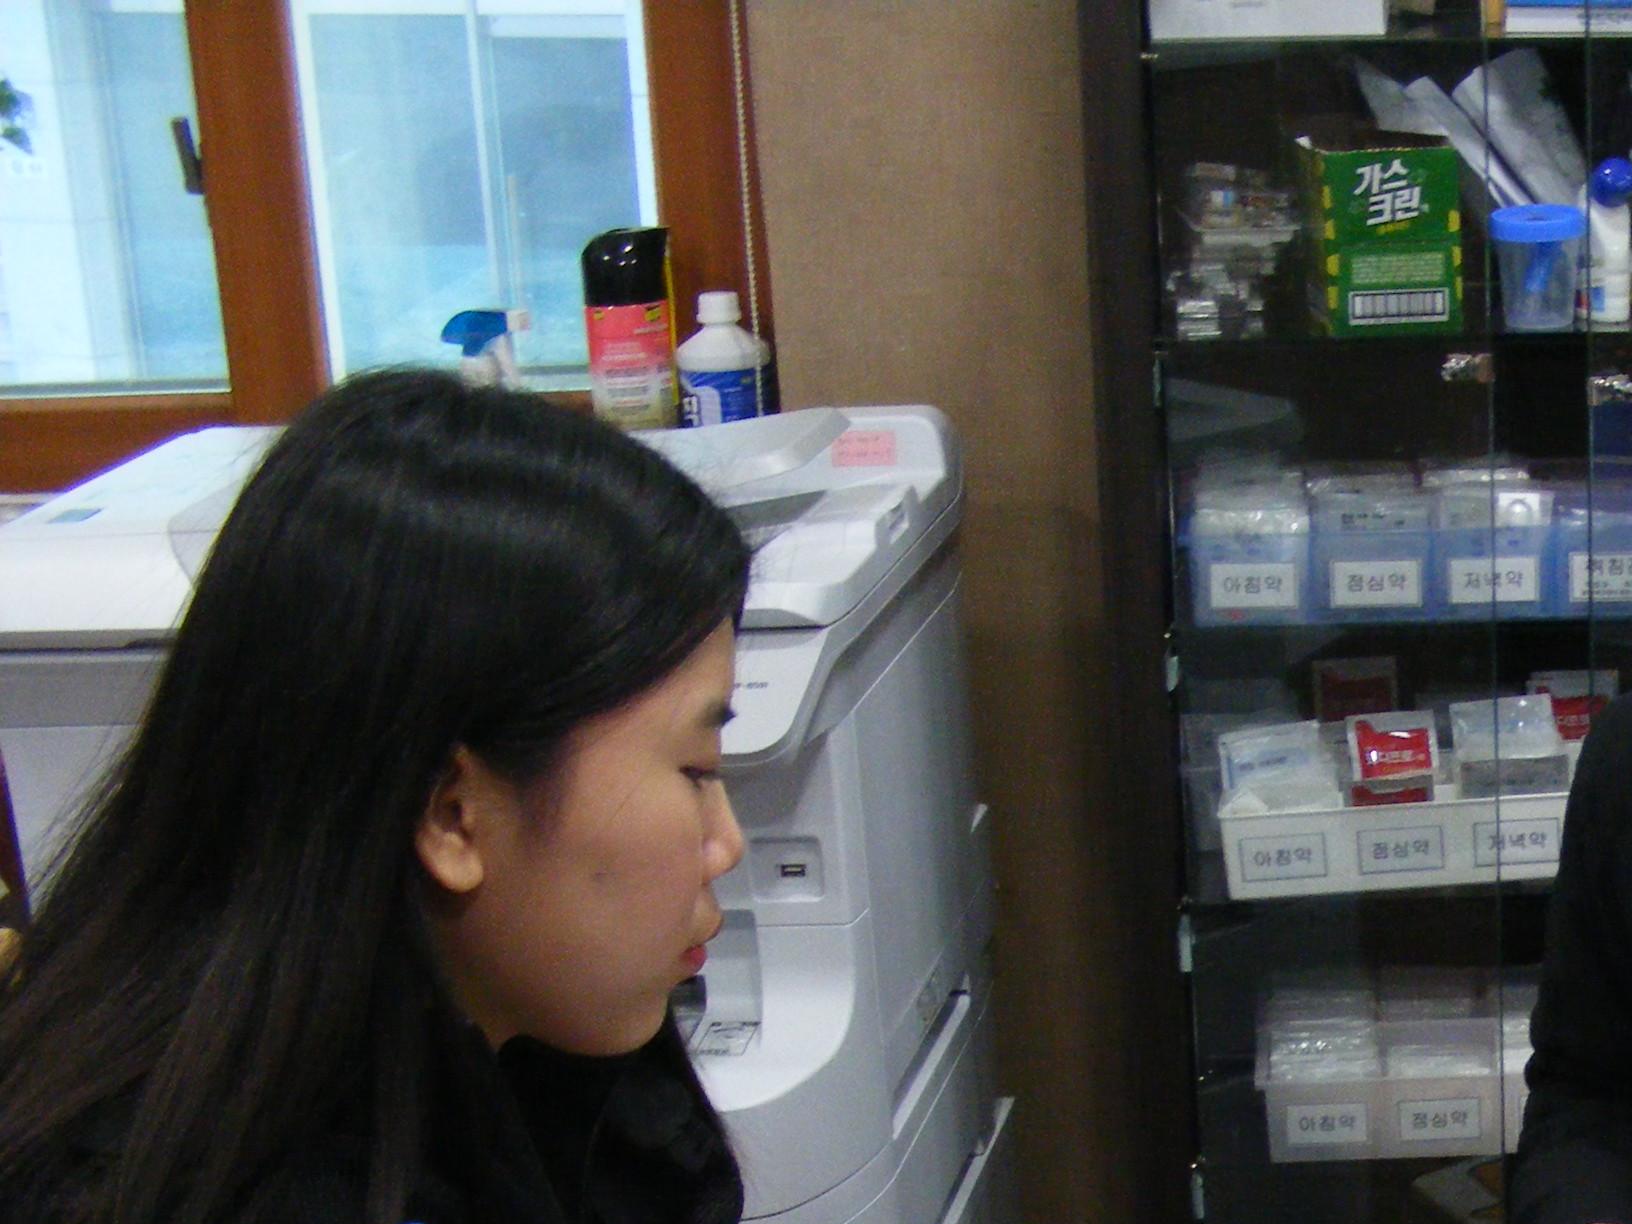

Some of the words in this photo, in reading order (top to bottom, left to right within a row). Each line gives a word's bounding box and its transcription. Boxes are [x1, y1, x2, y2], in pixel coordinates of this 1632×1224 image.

[1353, 158, 1410, 196] 가스
[1366, 186, 1422, 226] 크린
[1223, 575, 1283, 595] 아침약
[1347, 573, 1406, 593] 점심약
[1254, 848, 1313, 867] 아침약
[1372, 840, 1430, 860] 점심약
[1299, 1115, 1356, 1132] 아침약
[1412, 1110, 1468, 1129] 점심약
